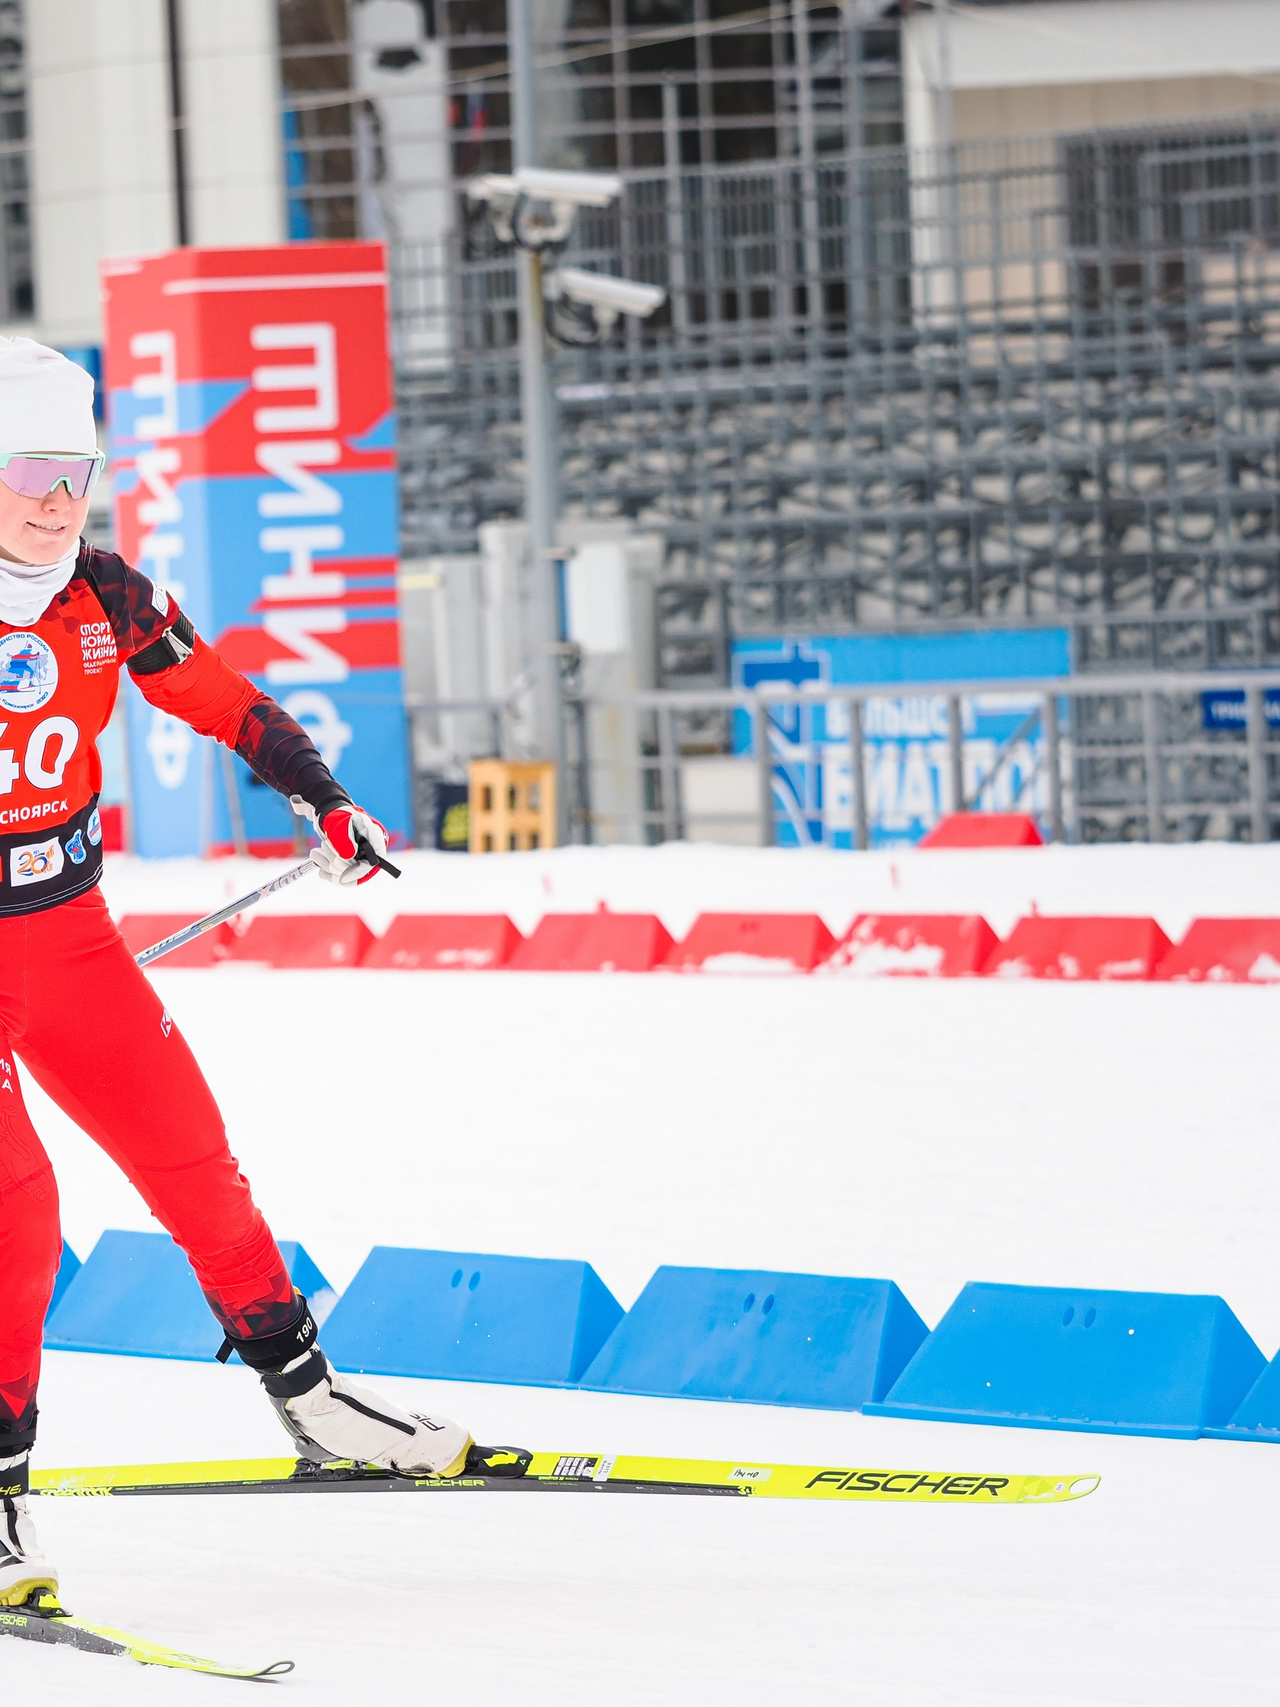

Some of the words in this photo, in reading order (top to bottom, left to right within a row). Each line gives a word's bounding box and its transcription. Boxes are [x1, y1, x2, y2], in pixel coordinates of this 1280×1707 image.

[129, 331, 196, 790] ФНИШ
[250, 322, 354, 774] ФИНИШ
[80, 622, 110, 636] СПОРТ
[26, 634, 49, 652] РОССИИ
[82, 646, 118, 660] ЖИЗНИ
[256, 860, 317, 900] SWIX
[296, 1316, 312, 1344] 190
[415, 1479, 485, 1487] FISCHER
[804, 1471, 1010, 1496] FISCHER
